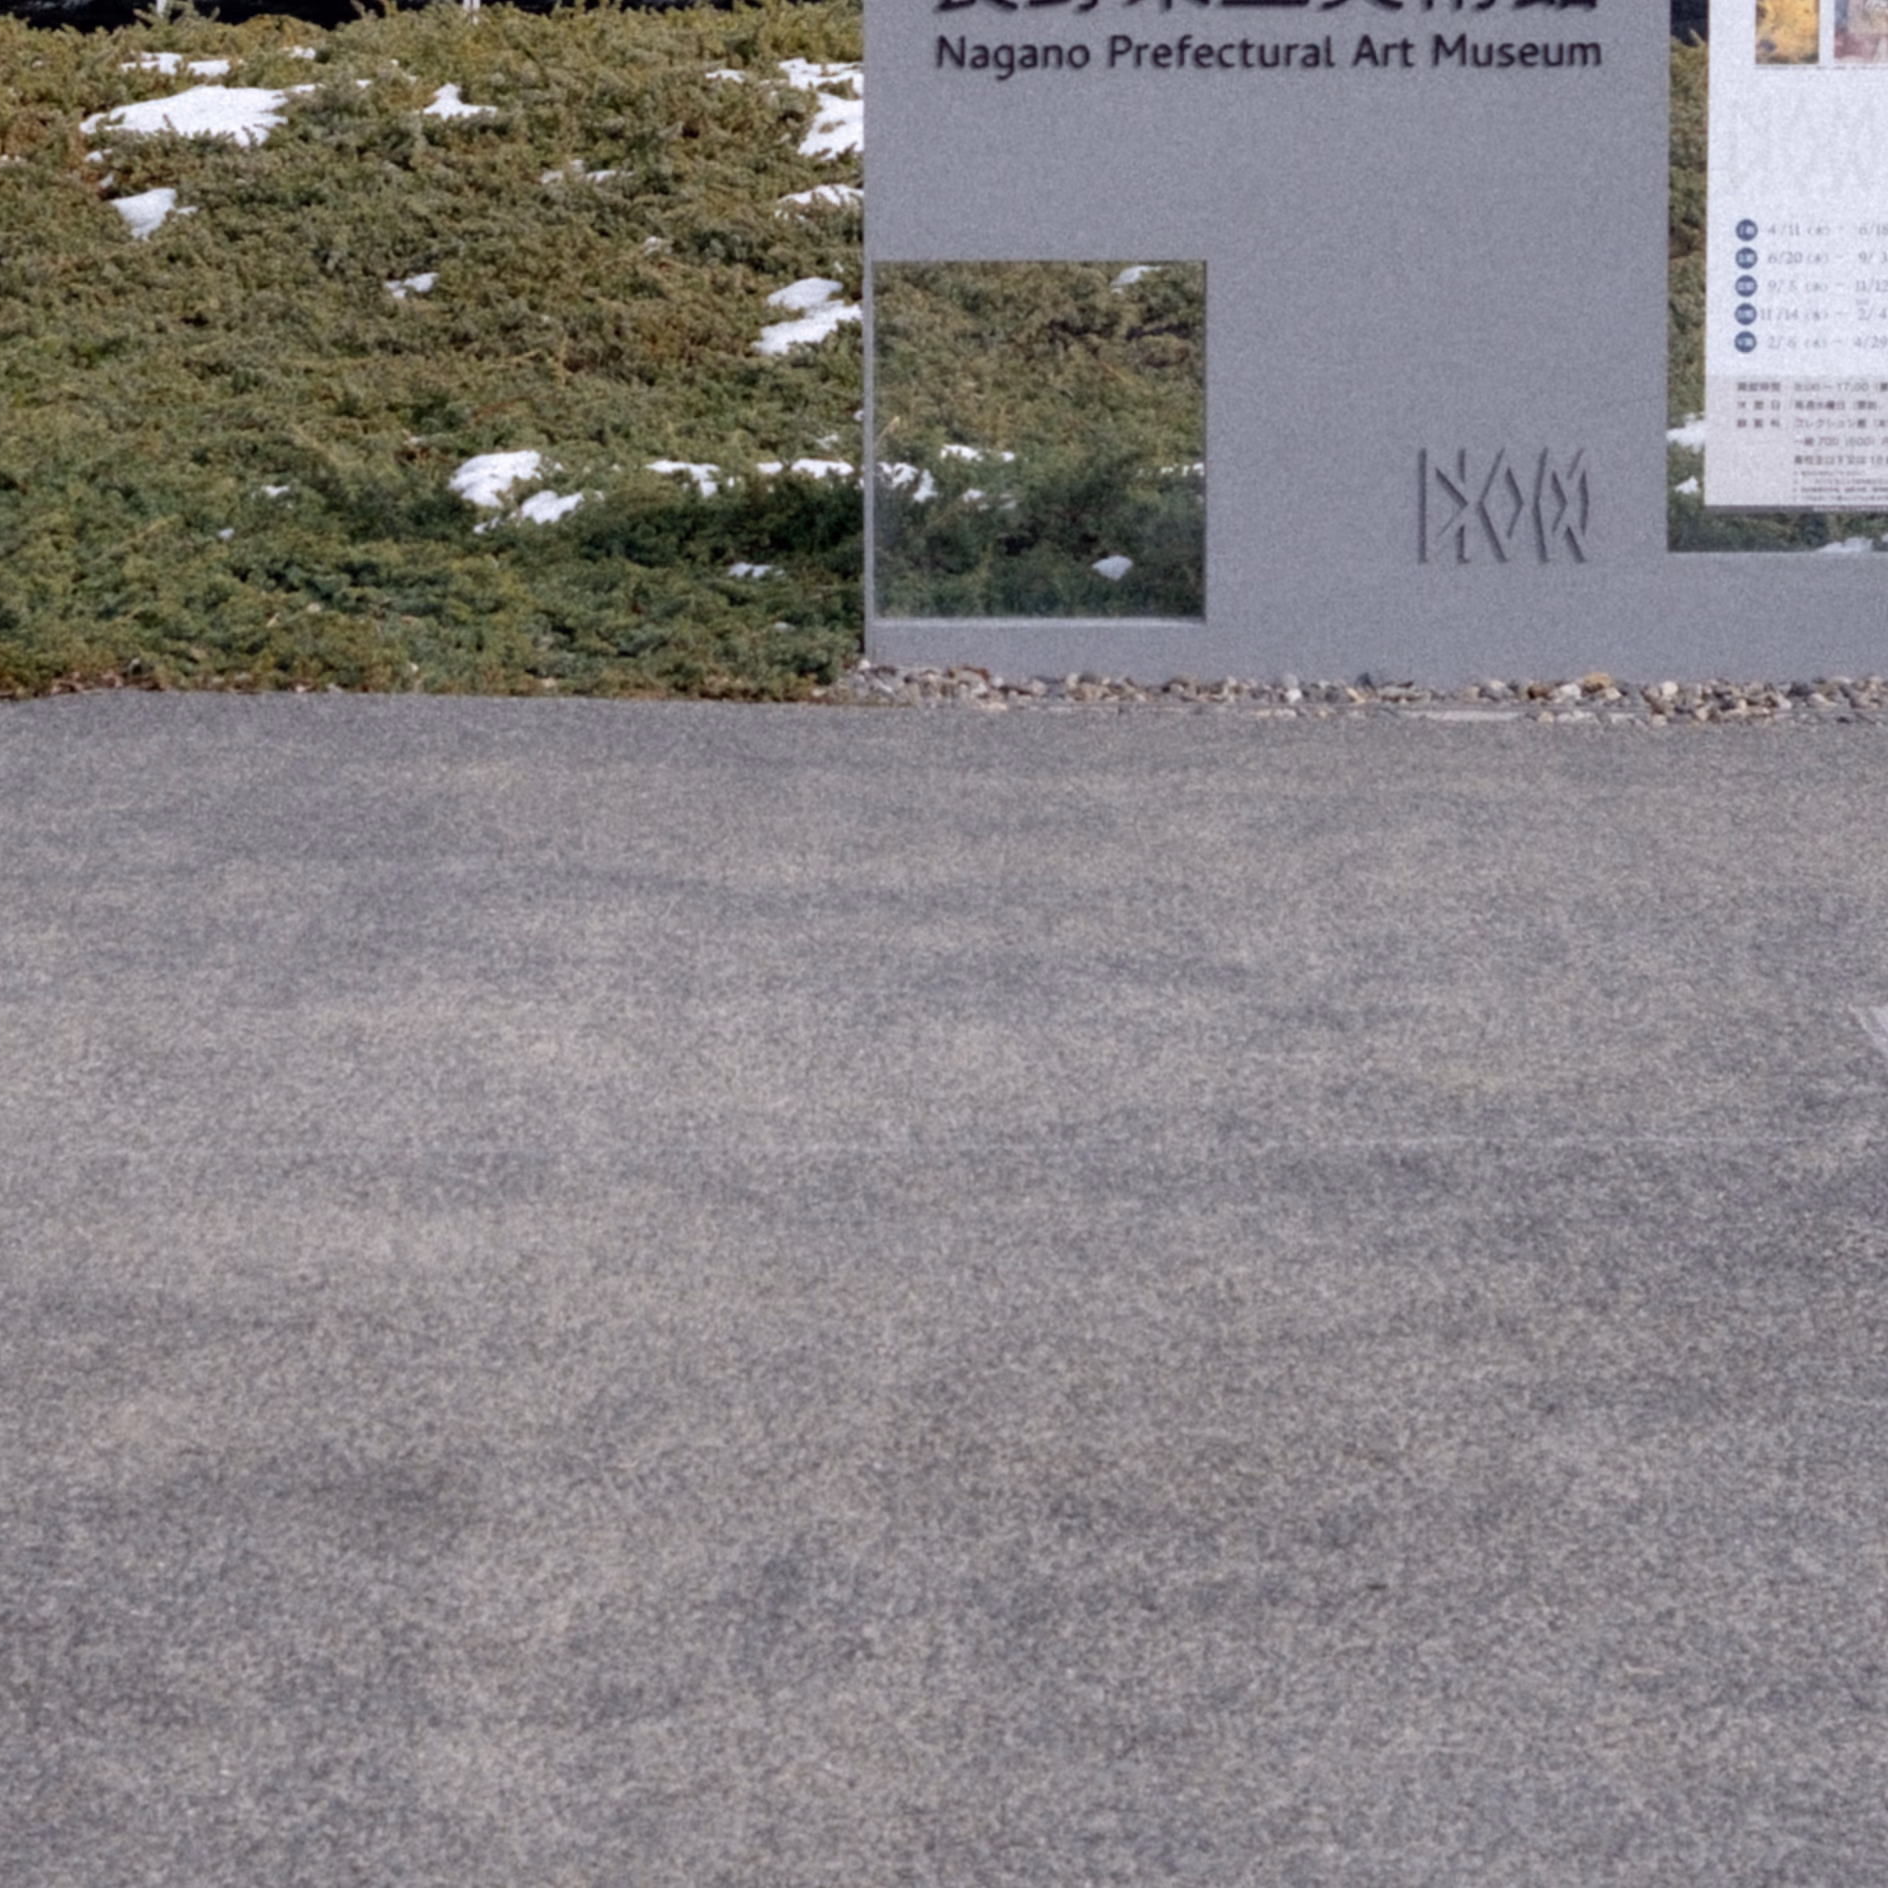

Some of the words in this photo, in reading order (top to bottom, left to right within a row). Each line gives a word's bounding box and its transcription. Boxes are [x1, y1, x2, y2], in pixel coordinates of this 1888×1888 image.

[935, 35, 1091, 80] Nagano
[1109, 34, 1334, 69] Prefectural
[1352, 35, 1415, 69] Art
[1432, 34, 1603, 69] Museum
